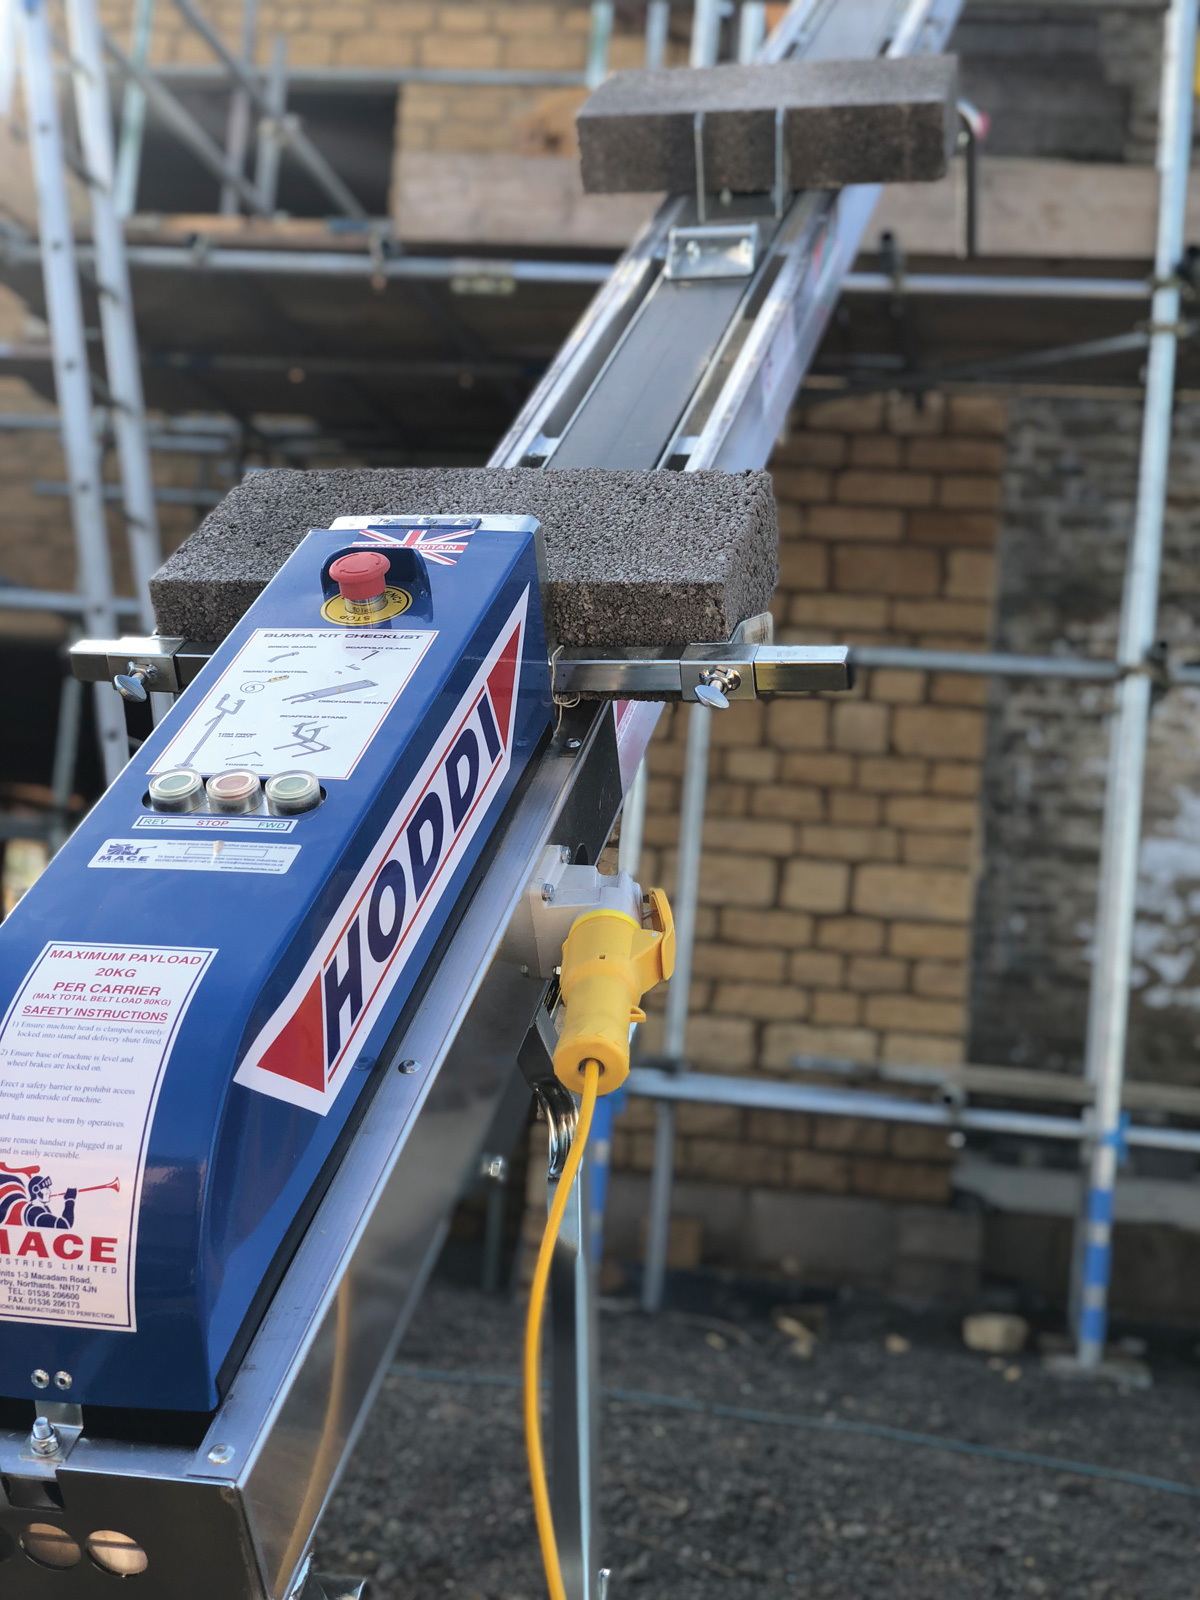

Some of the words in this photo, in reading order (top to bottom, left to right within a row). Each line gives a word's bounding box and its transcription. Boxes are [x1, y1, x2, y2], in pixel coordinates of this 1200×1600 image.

[196, 820, 230, 828] STOP
[324, 692, 502, 1069] HODDI
[49, 949, 126, 962] MAXIMUM
[128, 953, 202, 965] PAYLOAD
[95, 968, 137, 978] 20KG
[53, 982, 86, 993] PER
[90, 984, 161, 996] CARRIER
[59, 994, 88, 1002] TOTAL
[90, 995, 114, 1003] BELT
[115, 996, 142, 1005] LOAD
[143, 998, 172, 1007] 80KG)
[22, 1005, 72, 1016] SAFETY
[74, 1008, 169, 1022] INSTRUCTIONS
[20, 1021, 47, 1029] Ensure
[49, 1022, 76, 1031] machine
[78, 1024, 95, 1032] head
[96, 1025, 102, 1033] is
[103, 1025, 133, 1036] clamped
[17, 1030, 40, 1038] locked
[42, 1031, 55, 1039] into
[57, 1032, 76, 1040] stand
[78, 1033, 91, 1041] and
[91, 1034, 121, 1044] delivery
[122, 1035, 141, 1044] shute
[0, 1049, 8, 1057] 2)
[10, 1049, 34, 1058] Ensure
[36, 1051, 51, 1059] base
[53, 1051, 62, 1060] of
[62, 1053, 92, 1061] machine
[101, 1054, 119, 1062] level
[120, 1055, 134, 1063] and
[6, 1059, 28, 1067] wheel
[29, 1060, 52, 1069] brakes
[53, 1062, 65, 1070] are
[66, 1062, 90, 1071] locked
[0, 1079, 19, 1088] Erect
[26, 1081, 47, 1090] safety
[49, 1082, 73, 1091] barrier
[74, 1084, 82, 1092] to
[82, 1085, 111, 1094] prohibit
[112, 1087, 136, 1095] access
[0, 1091, 25, 1100] hrough
[26, 1093, 60, 1101] underside
[62, 1094, 70, 1102] of
[0, 1113, 10, 1121] ard
[11, 1113, 26, 1121] hats
[27, 1115, 45, 1123] must
[56, 1117, 75, 1125] worn
[76, 1117, 86, 1126] by
[13, 1137, 38, 1145] remote
[39, 1138, 67, 1147] handset
[68, 1140, 74, 1148] is
[75, 1141, 106, 1151] plugged
[107, 1142, 114, 1150] in
[115, 1143, 123, 1151] at
[13, 1148, 19, 1156] is
[20, 1149, 42, 1159] easily
[0, 1257, 53, 1269] STRIES
[62, 1262, 118, 1274] LIMITED
[0, 1269, 15, 1278] nits
[17, 1271, 29, 1279] 1-3
[30, 1272, 68, 1282] Macadam
[8, 1287, 26, 1296] TEL:
[27, 1289, 51, 1298] 01536
[59, 1283, 80, 1293] NN17
[82, 1285, 97, 1293] 4JN
[28, 1297, 51, 1306] 01536
[53, 1300, 80, 1309] 206173
[16, 1305, 66, 1315] MANUFACTURED
[76, 1310, 115, 1319] PERFECTION
